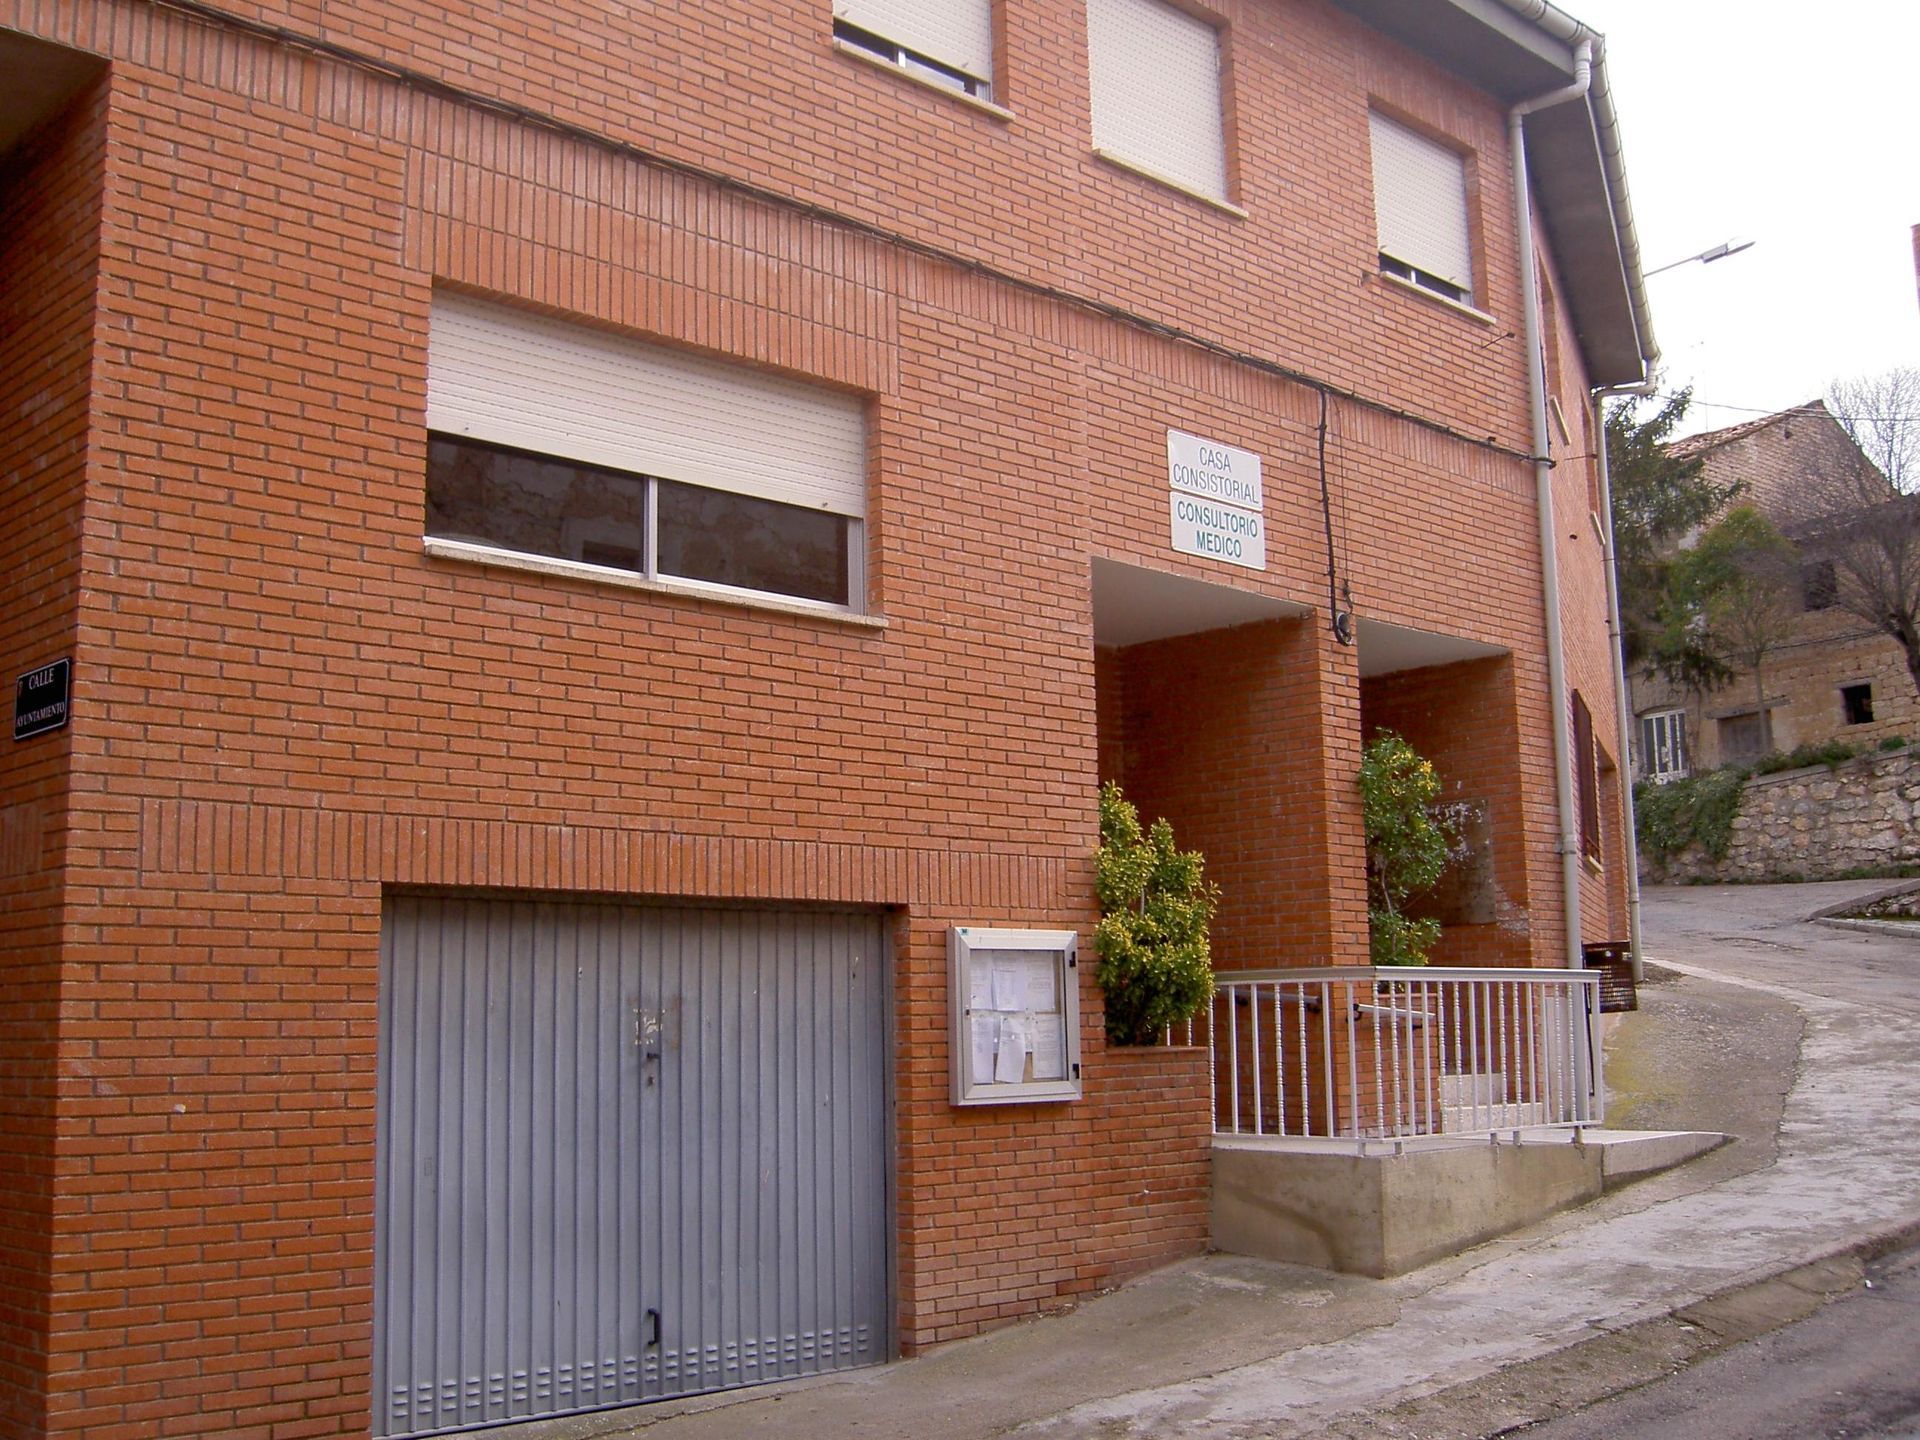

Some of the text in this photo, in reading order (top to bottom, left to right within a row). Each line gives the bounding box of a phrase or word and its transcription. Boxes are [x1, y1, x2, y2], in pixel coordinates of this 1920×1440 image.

[1199, 446, 1232, 473] CASA
[1173, 463, 1259, 504] CONSISTORIAL
[1177, 500, 1258, 538] CONSULTORIO
[1196, 530, 1242, 558] MEDICO
[28, 667, 55, 690] CALLE
[16, 701, 65, 728] AYUNTAMIENTO
